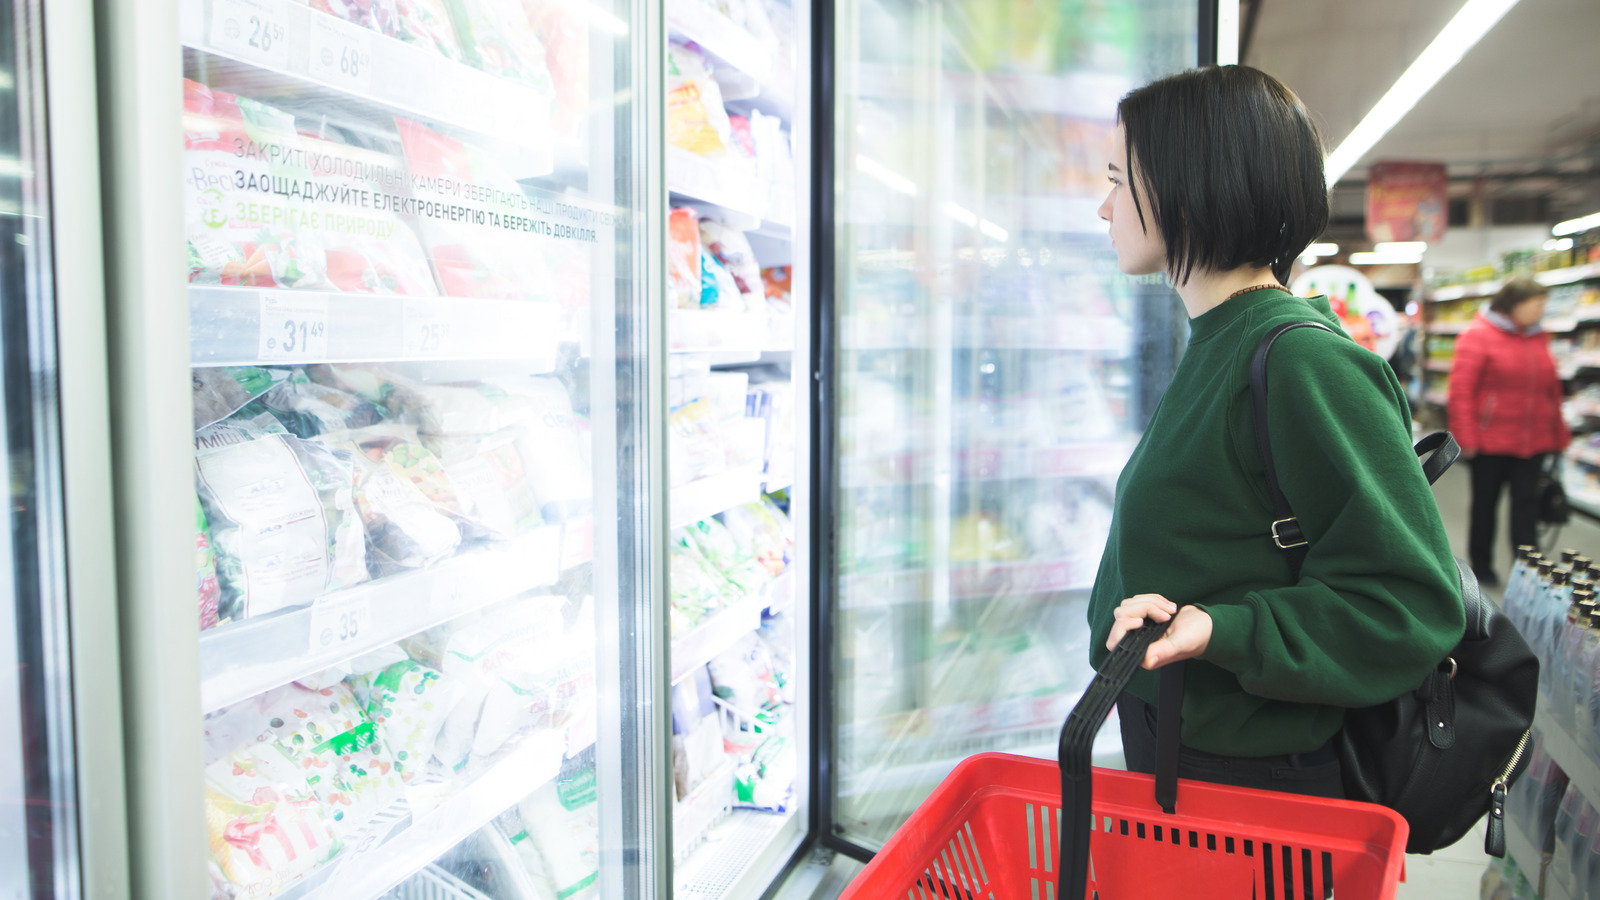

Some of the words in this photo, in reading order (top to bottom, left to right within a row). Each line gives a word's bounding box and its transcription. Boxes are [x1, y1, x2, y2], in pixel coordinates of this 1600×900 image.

[248, 15, 272, 52] 26
[340, 45, 360, 78] 68
[233, 137, 308, 170] ЗАКРИТІ
[313, 152, 407, 186] ХОЛОДИЛЬНІ
[411, 173, 460, 198] КАМЕРИ
[464, 184, 528, 210] ЗБЕРІГАЮТЬ
[233, 169, 369, 208] ЗАОЩАДЖУЙТЕ
[374, 192, 486, 226] ЕЛЕКТРОЕНЕРГІЮ
[488, 211, 500, 228] ТА
[503, 214, 552, 236] БЕРЕЖІТЬ
[235, 201, 319, 230] ЗБЕРІГАЄ
[324, 213, 394, 240] ПРИРОДУ
[283, 319, 307, 352] 31
[311, 320, 325, 337] 49
[420, 324, 440, 351] 25
[340, 611, 358, 641] 35
